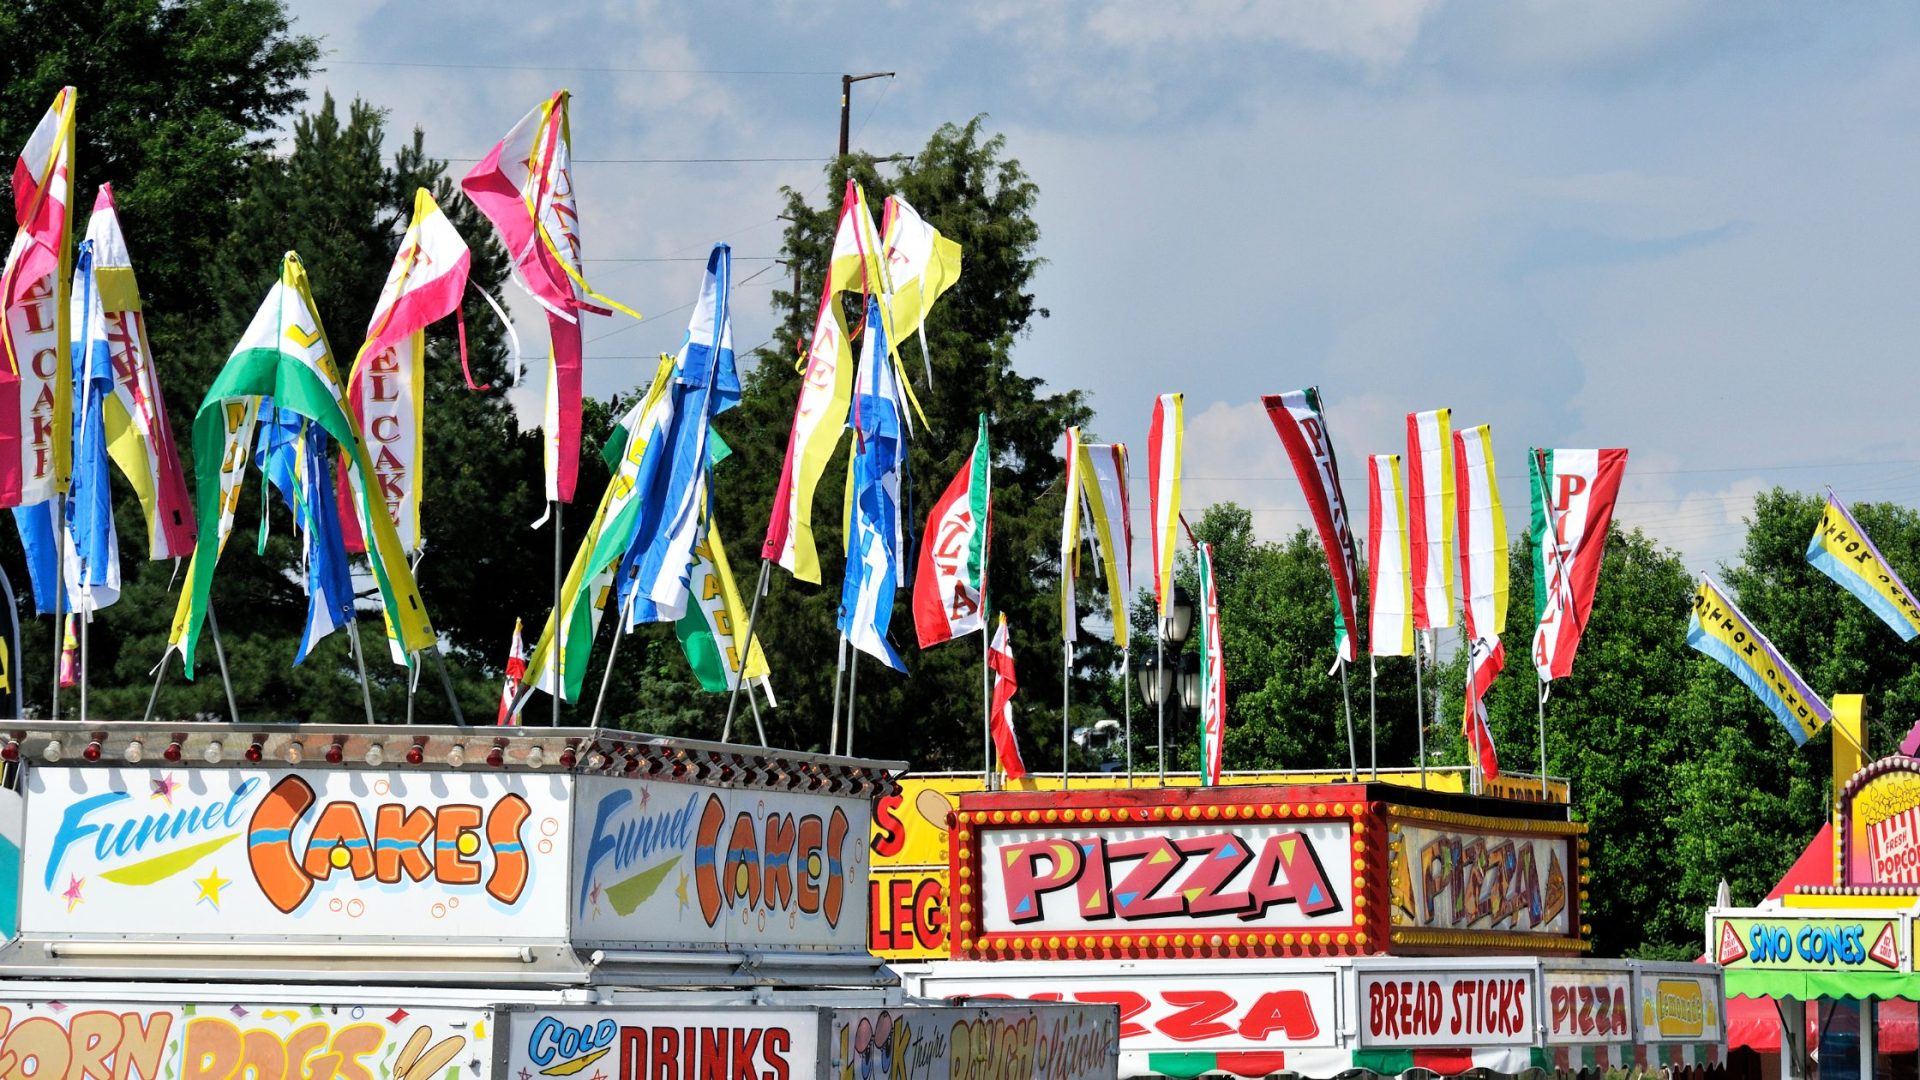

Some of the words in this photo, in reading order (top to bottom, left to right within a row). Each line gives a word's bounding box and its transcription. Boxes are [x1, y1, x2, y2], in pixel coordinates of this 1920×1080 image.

[44, 776, 261, 892] Funnel
[247, 773, 532, 914] CAKES
[579, 788, 699, 921] Funnel
[695, 792, 849, 930] CAKES
[1877, 845, 1920, 879] POPCO
[1885, 831, 1907, 854] FRESH
[999, 832, 1343, 925] PIZZA
[1421, 835, 1544, 929] PIZZA
[869, 877, 949, 950] LEG
[1749, 923, 1793, 963] SNO
[1796, 924, 1866, 967] CONES
[0, 1006, 173, 1080] ORN
[1369, 980, 1443, 1040] BREAD
[1451, 978, 1525, 1038] STICKS
[1550, 985, 1628, 1036] PIZZA
[528, 1015, 618, 1067] COLD
[619, 1026, 791, 1080] DRINKS
